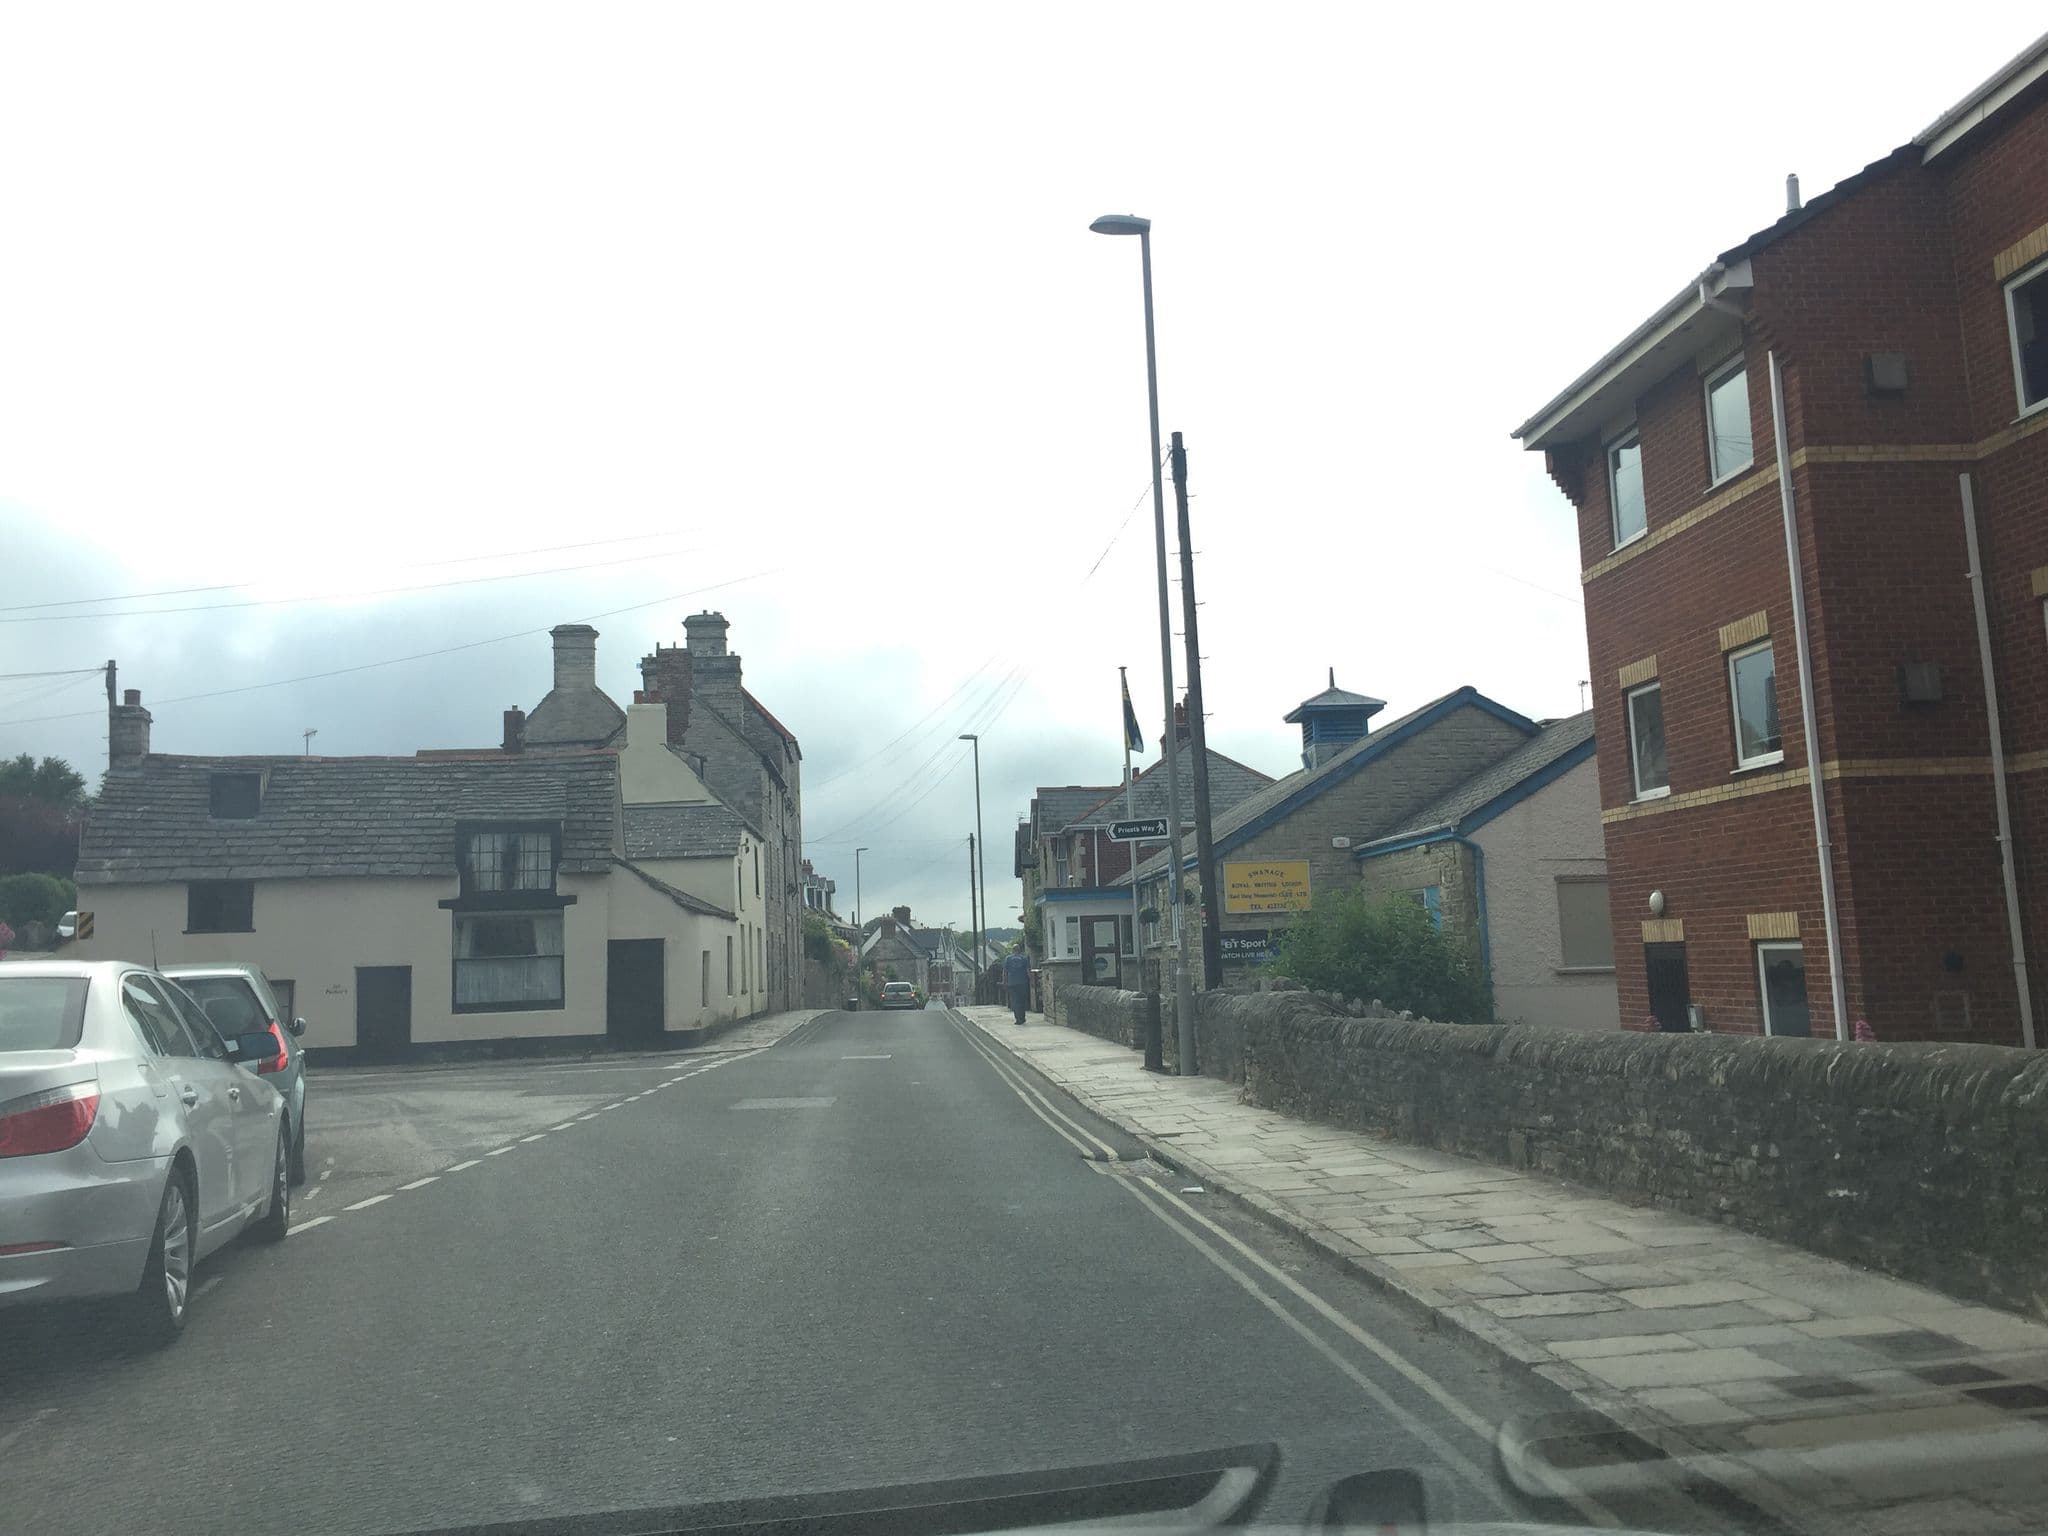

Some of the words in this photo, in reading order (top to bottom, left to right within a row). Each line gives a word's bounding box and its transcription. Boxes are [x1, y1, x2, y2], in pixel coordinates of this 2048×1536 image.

[1248, 869, 1285, 878] SWANAGE
[1224, 939, 1239, 949] BT
[1240, 940, 1267, 949] Sport
